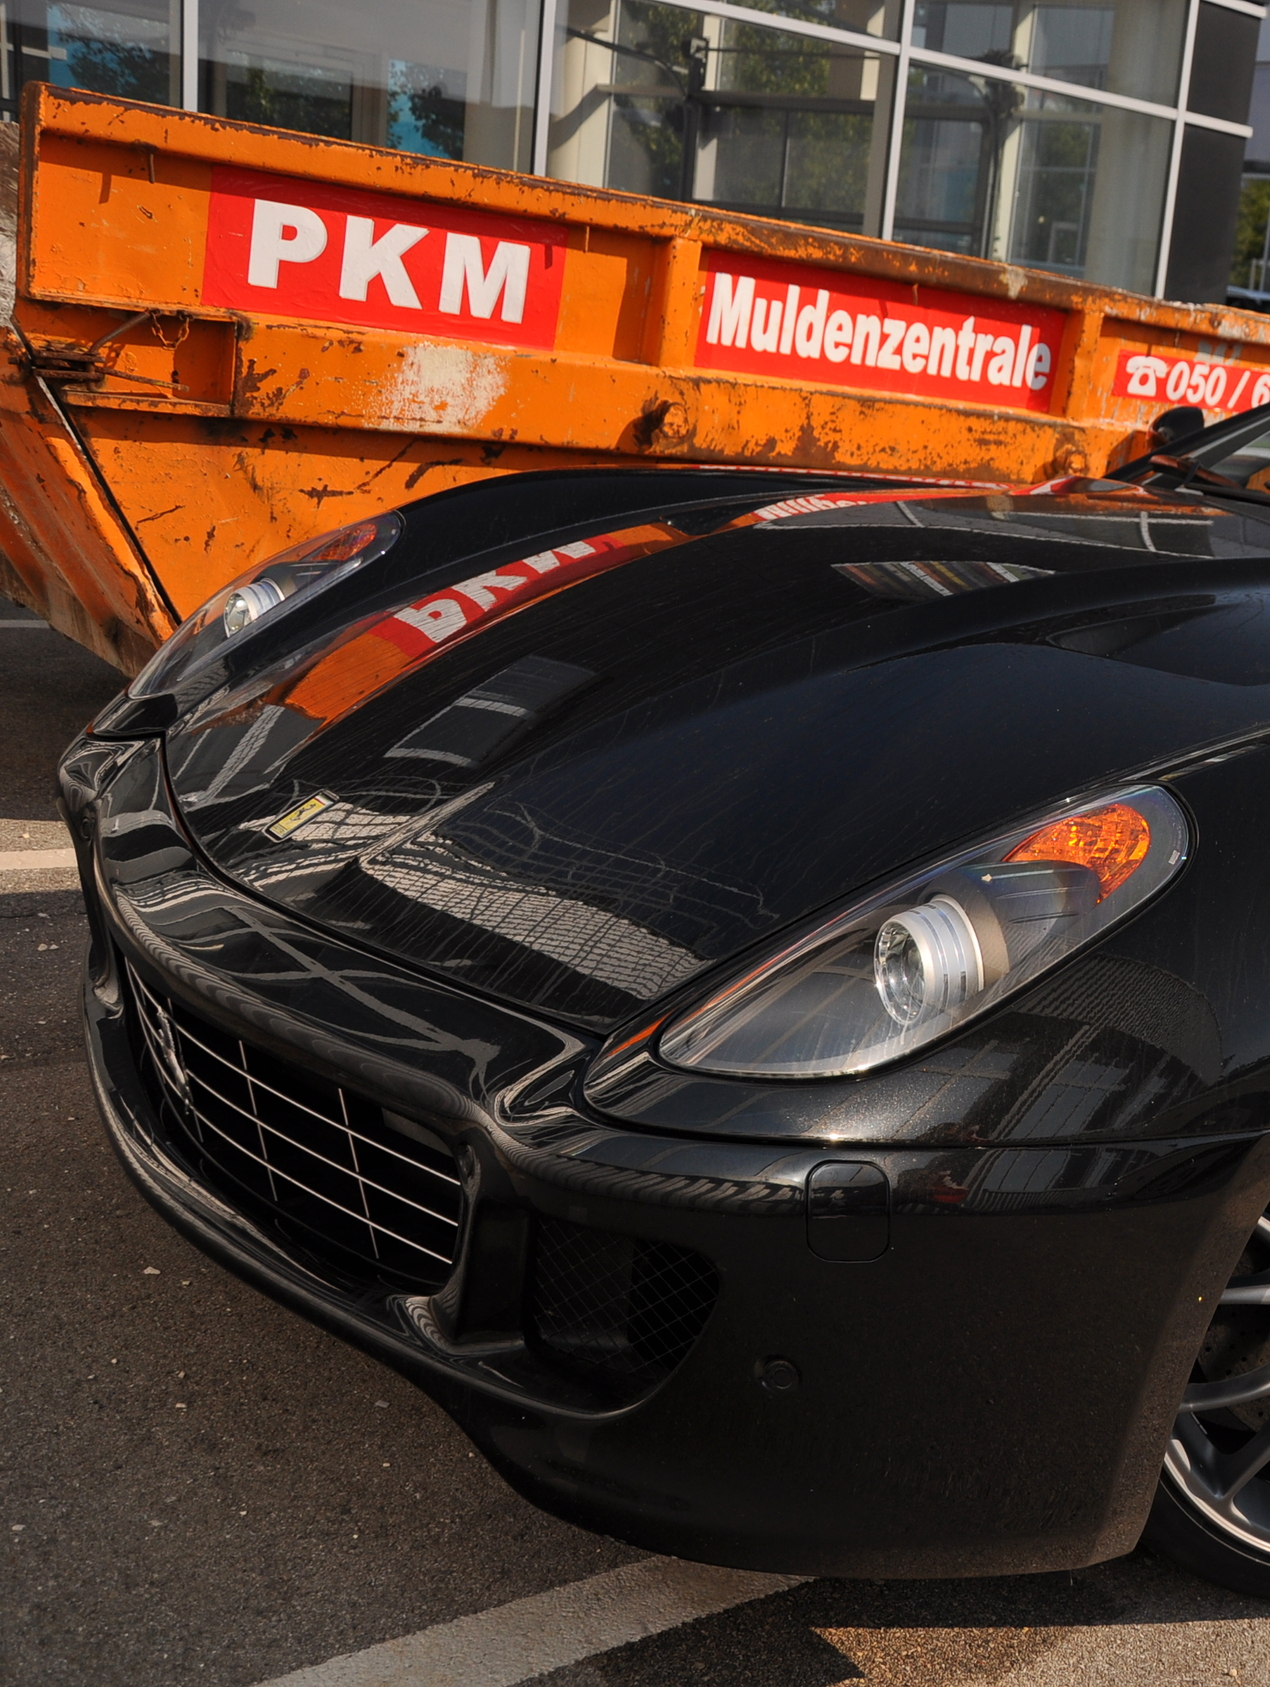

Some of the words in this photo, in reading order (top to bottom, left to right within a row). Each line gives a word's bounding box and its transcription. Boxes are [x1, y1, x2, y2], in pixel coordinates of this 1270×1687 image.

[248, 199, 531, 324] PKM
[706, 272, 1052, 390] Muldenzentrale
[1165, 361, 1227, 406] 050
